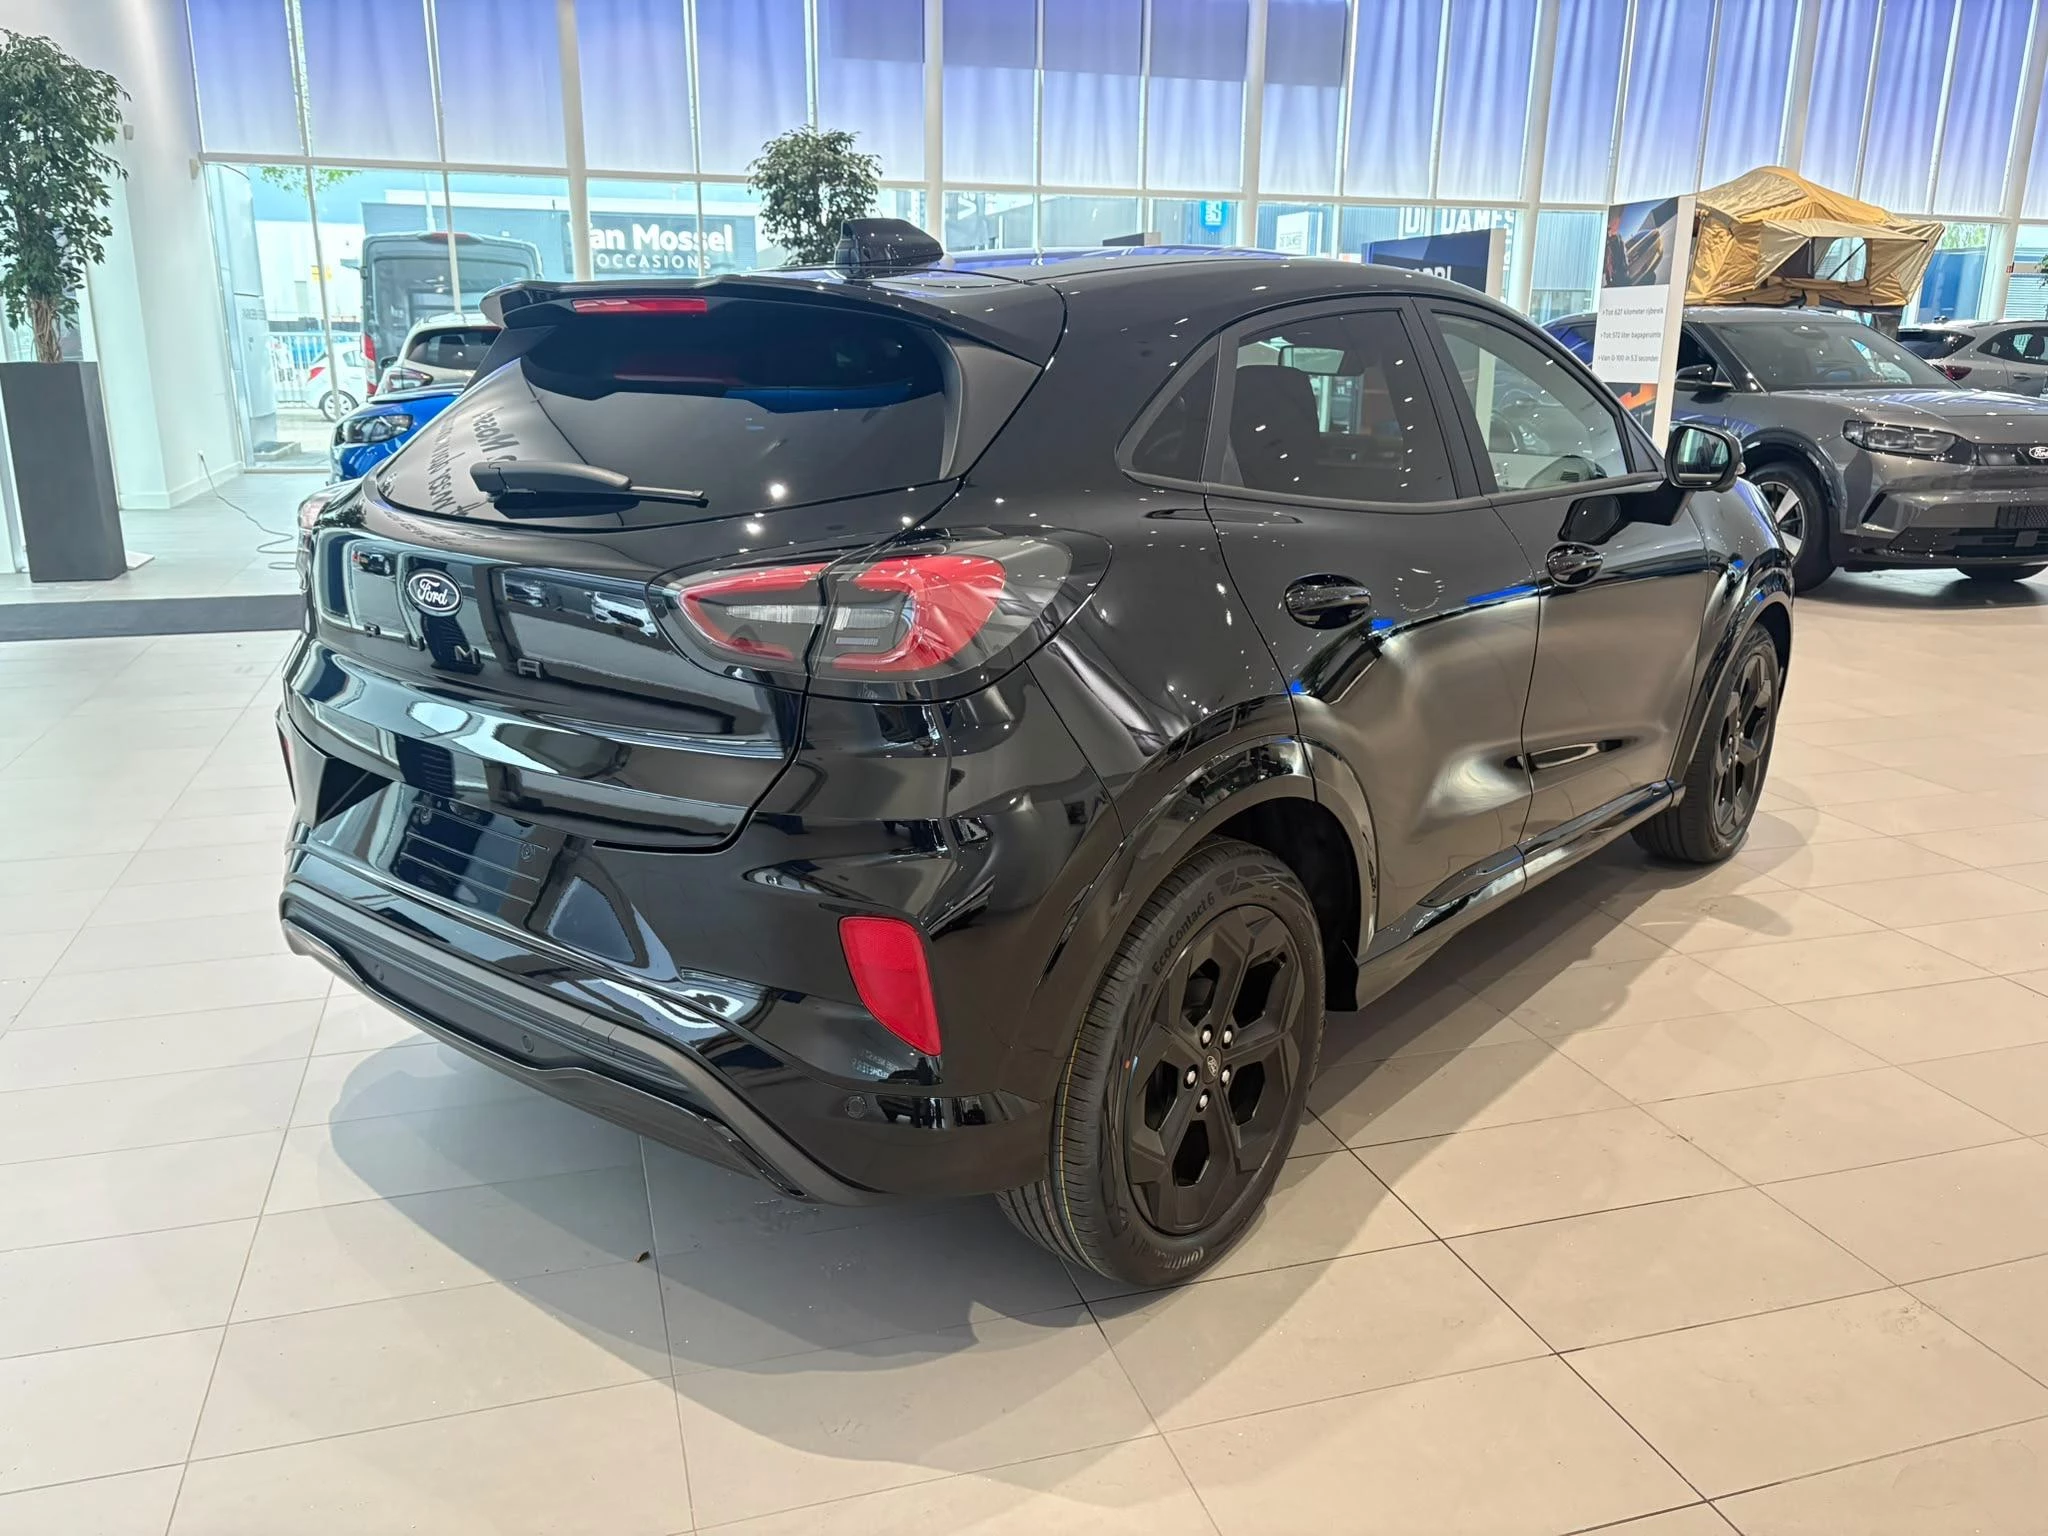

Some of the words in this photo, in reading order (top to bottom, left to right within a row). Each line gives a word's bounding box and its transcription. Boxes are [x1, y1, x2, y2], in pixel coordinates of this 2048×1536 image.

[567, 222, 626, 250] an
[632, 223, 734, 252] Mossel
[596, 253, 712, 270] OCCASIONS
[417, 578, 448, 605] Ford
[1152, 902, 1208, 976] EcoContact
[1207, 891, 1216, 906] 6
